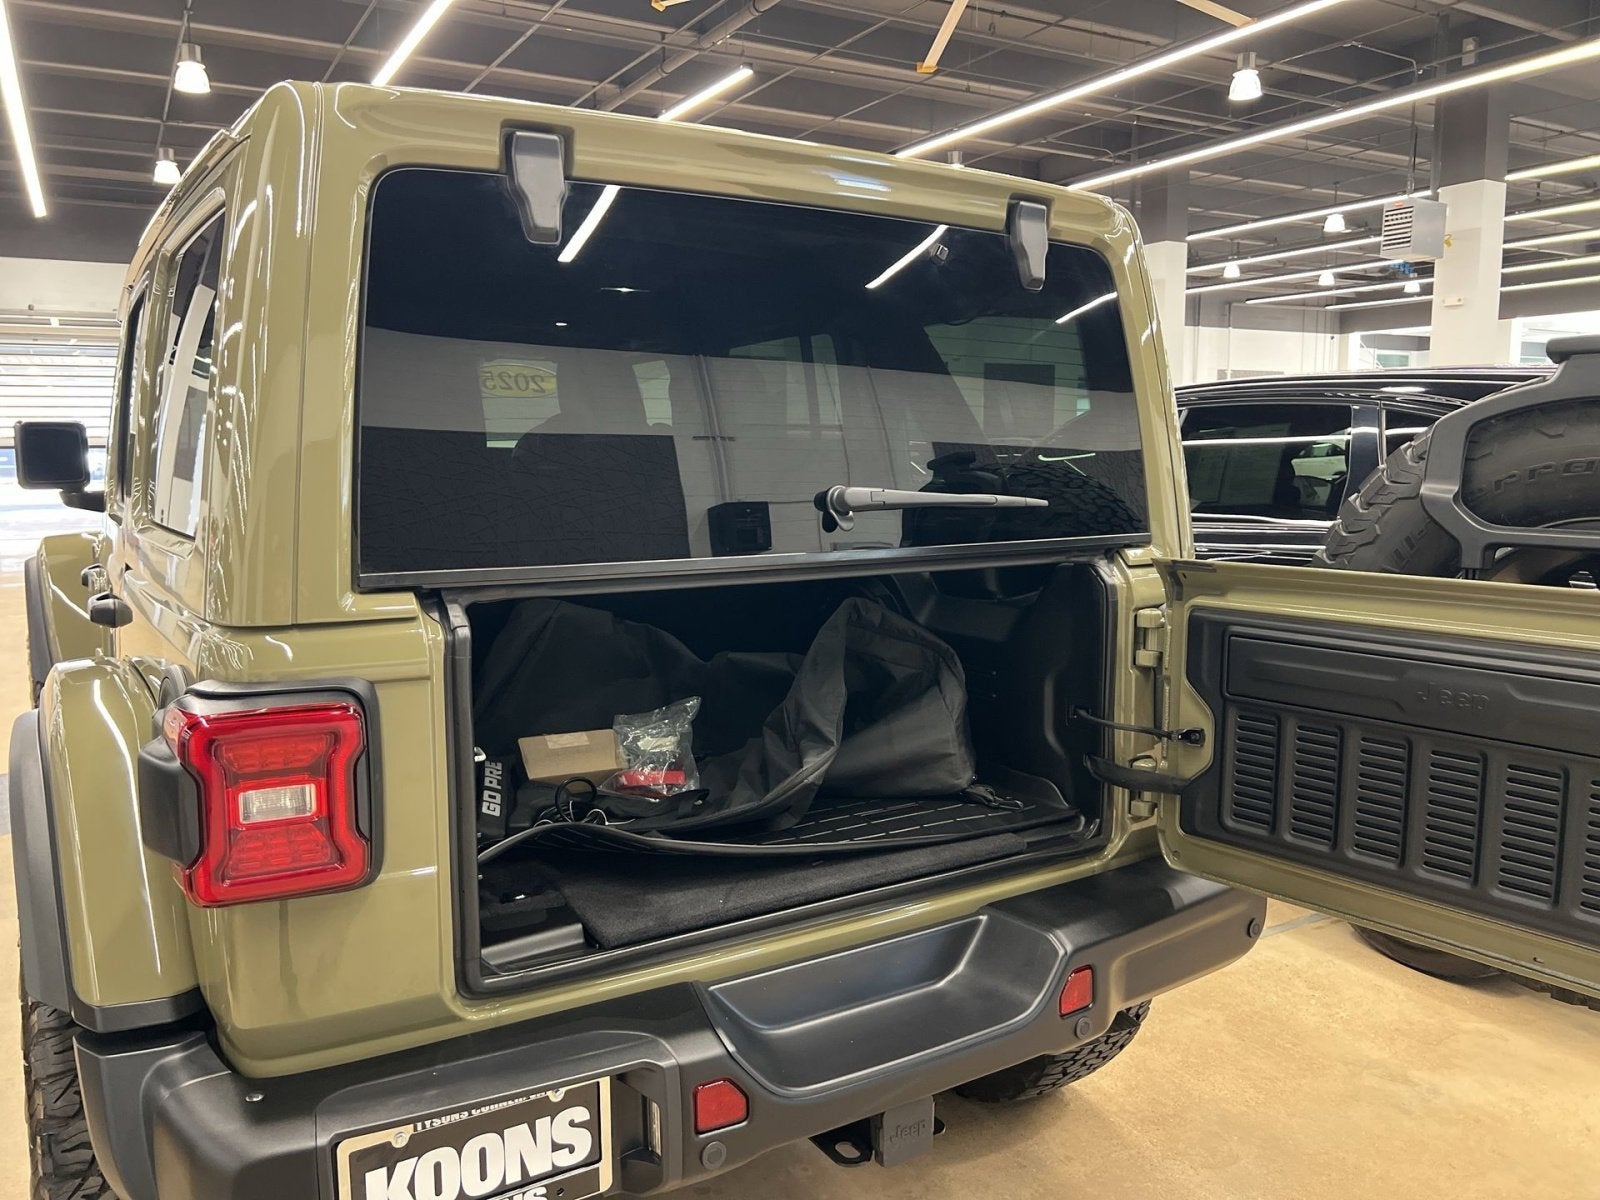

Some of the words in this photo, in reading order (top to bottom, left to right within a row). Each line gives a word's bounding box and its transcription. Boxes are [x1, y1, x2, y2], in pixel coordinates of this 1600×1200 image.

[1416, 681, 1489, 710] Jeep
[481, 789, 502, 817] GO
[365, 1106, 592, 1200] KOONS
